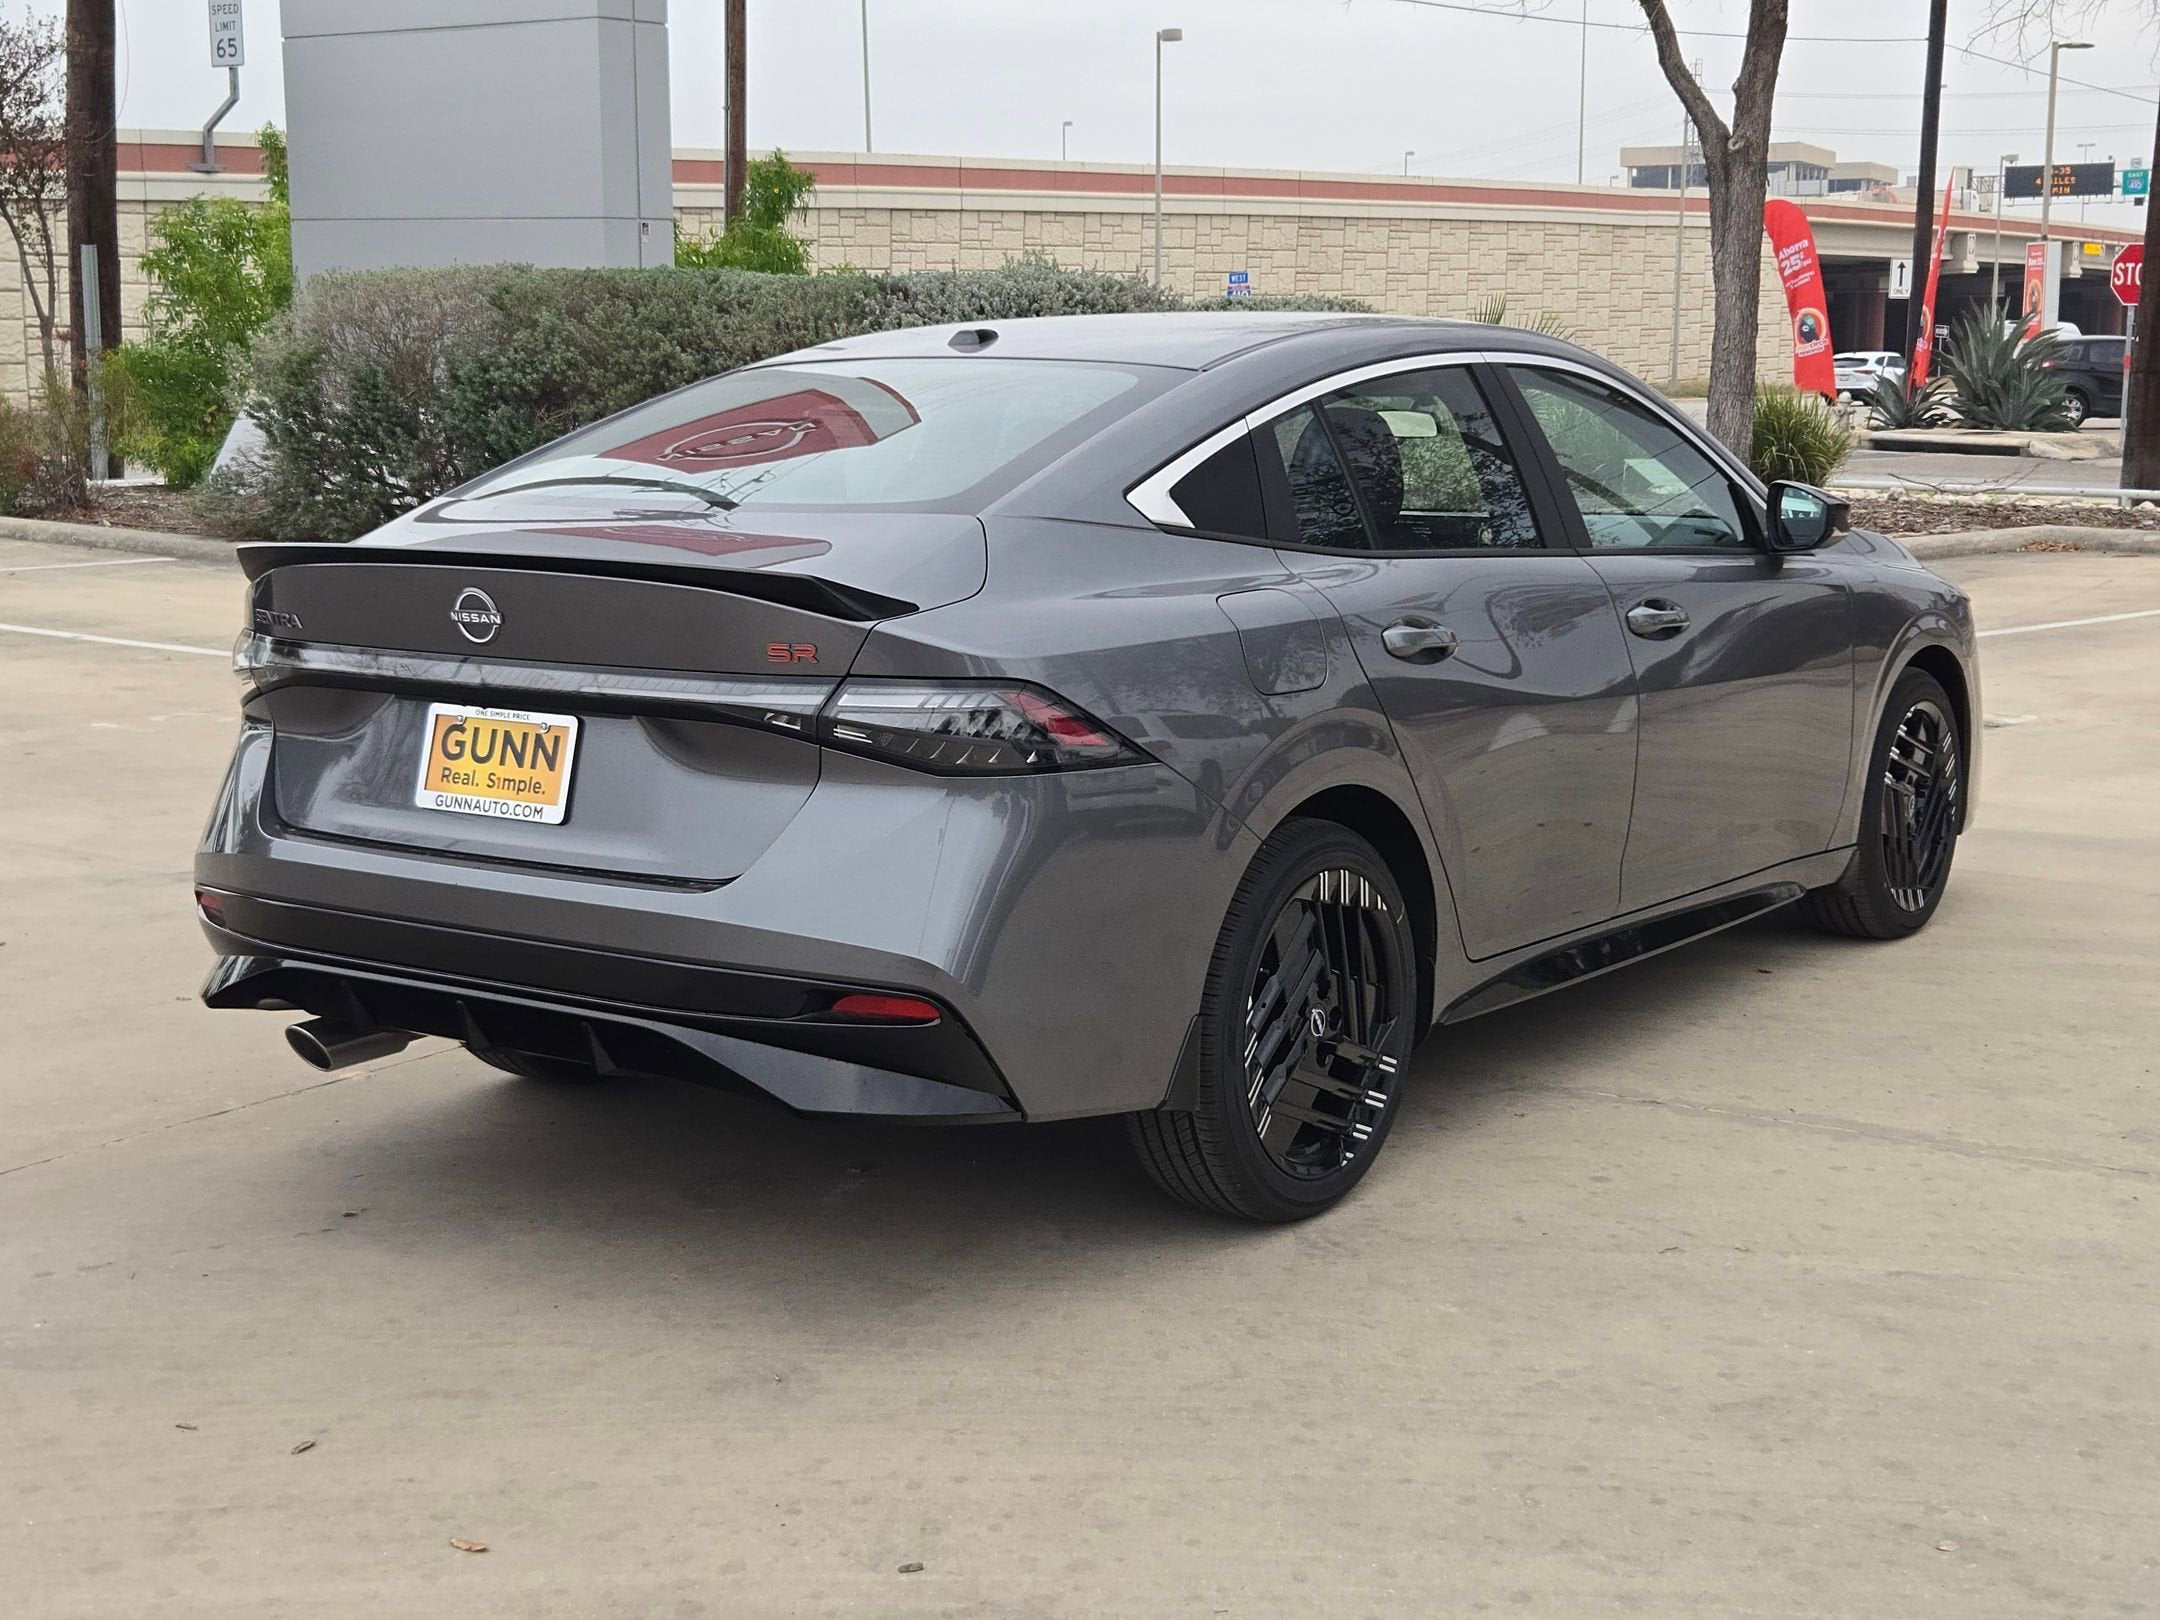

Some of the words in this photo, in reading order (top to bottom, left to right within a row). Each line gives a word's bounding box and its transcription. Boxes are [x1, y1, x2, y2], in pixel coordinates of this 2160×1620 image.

[211, 3, 239, 16] SPEED
[214, 20, 236, 32] LIMIT
[216, 37, 238, 59] 65
[1779, 239, 1809, 260] Ahorra
[1230, 274, 1247, 283] WEST
[1893, 288, 1910, 296] ONLY
[255, 608, 303, 629] SENTRA
[450, 610, 501, 624] NISSAN
[767, 642, 819, 664] SR
[475, 709, 489, 717] ONE
[490, 710, 511, 719] SIMPLE
[512, 712, 530, 720] PRICE
[441, 723, 561, 772] GUNN
[441, 766, 479, 788] Real.
[435, 794, 544, 820] GUNNAUTO.COM
